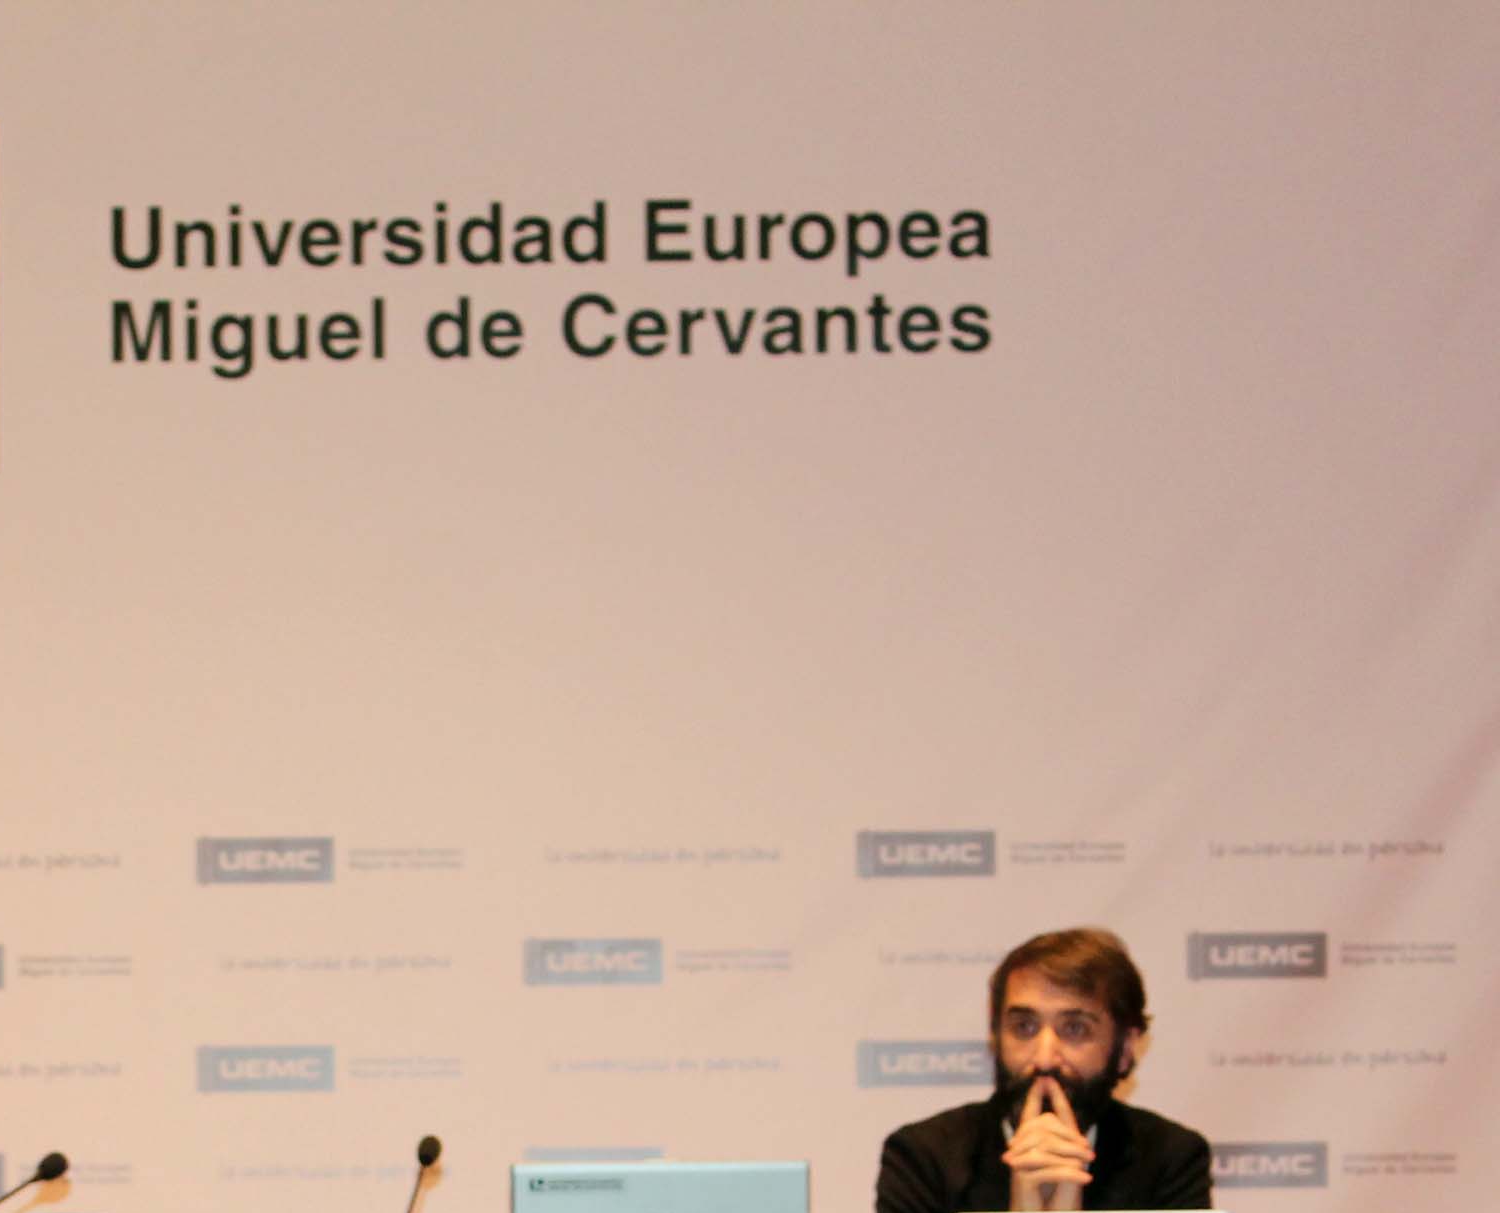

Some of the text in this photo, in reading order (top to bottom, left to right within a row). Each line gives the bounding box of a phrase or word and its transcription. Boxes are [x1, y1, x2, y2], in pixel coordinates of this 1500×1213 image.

[111, 199, 991, 278] Universidad Europea
[111, 292, 992, 380] Miguel de Cervantes
[219, 849, 321, 872] UEMC
[878, 842, 982, 866] UEMC
[1208, 944, 1313, 968] UEMC
[1213, 1153, 1315, 1177] UEMC
